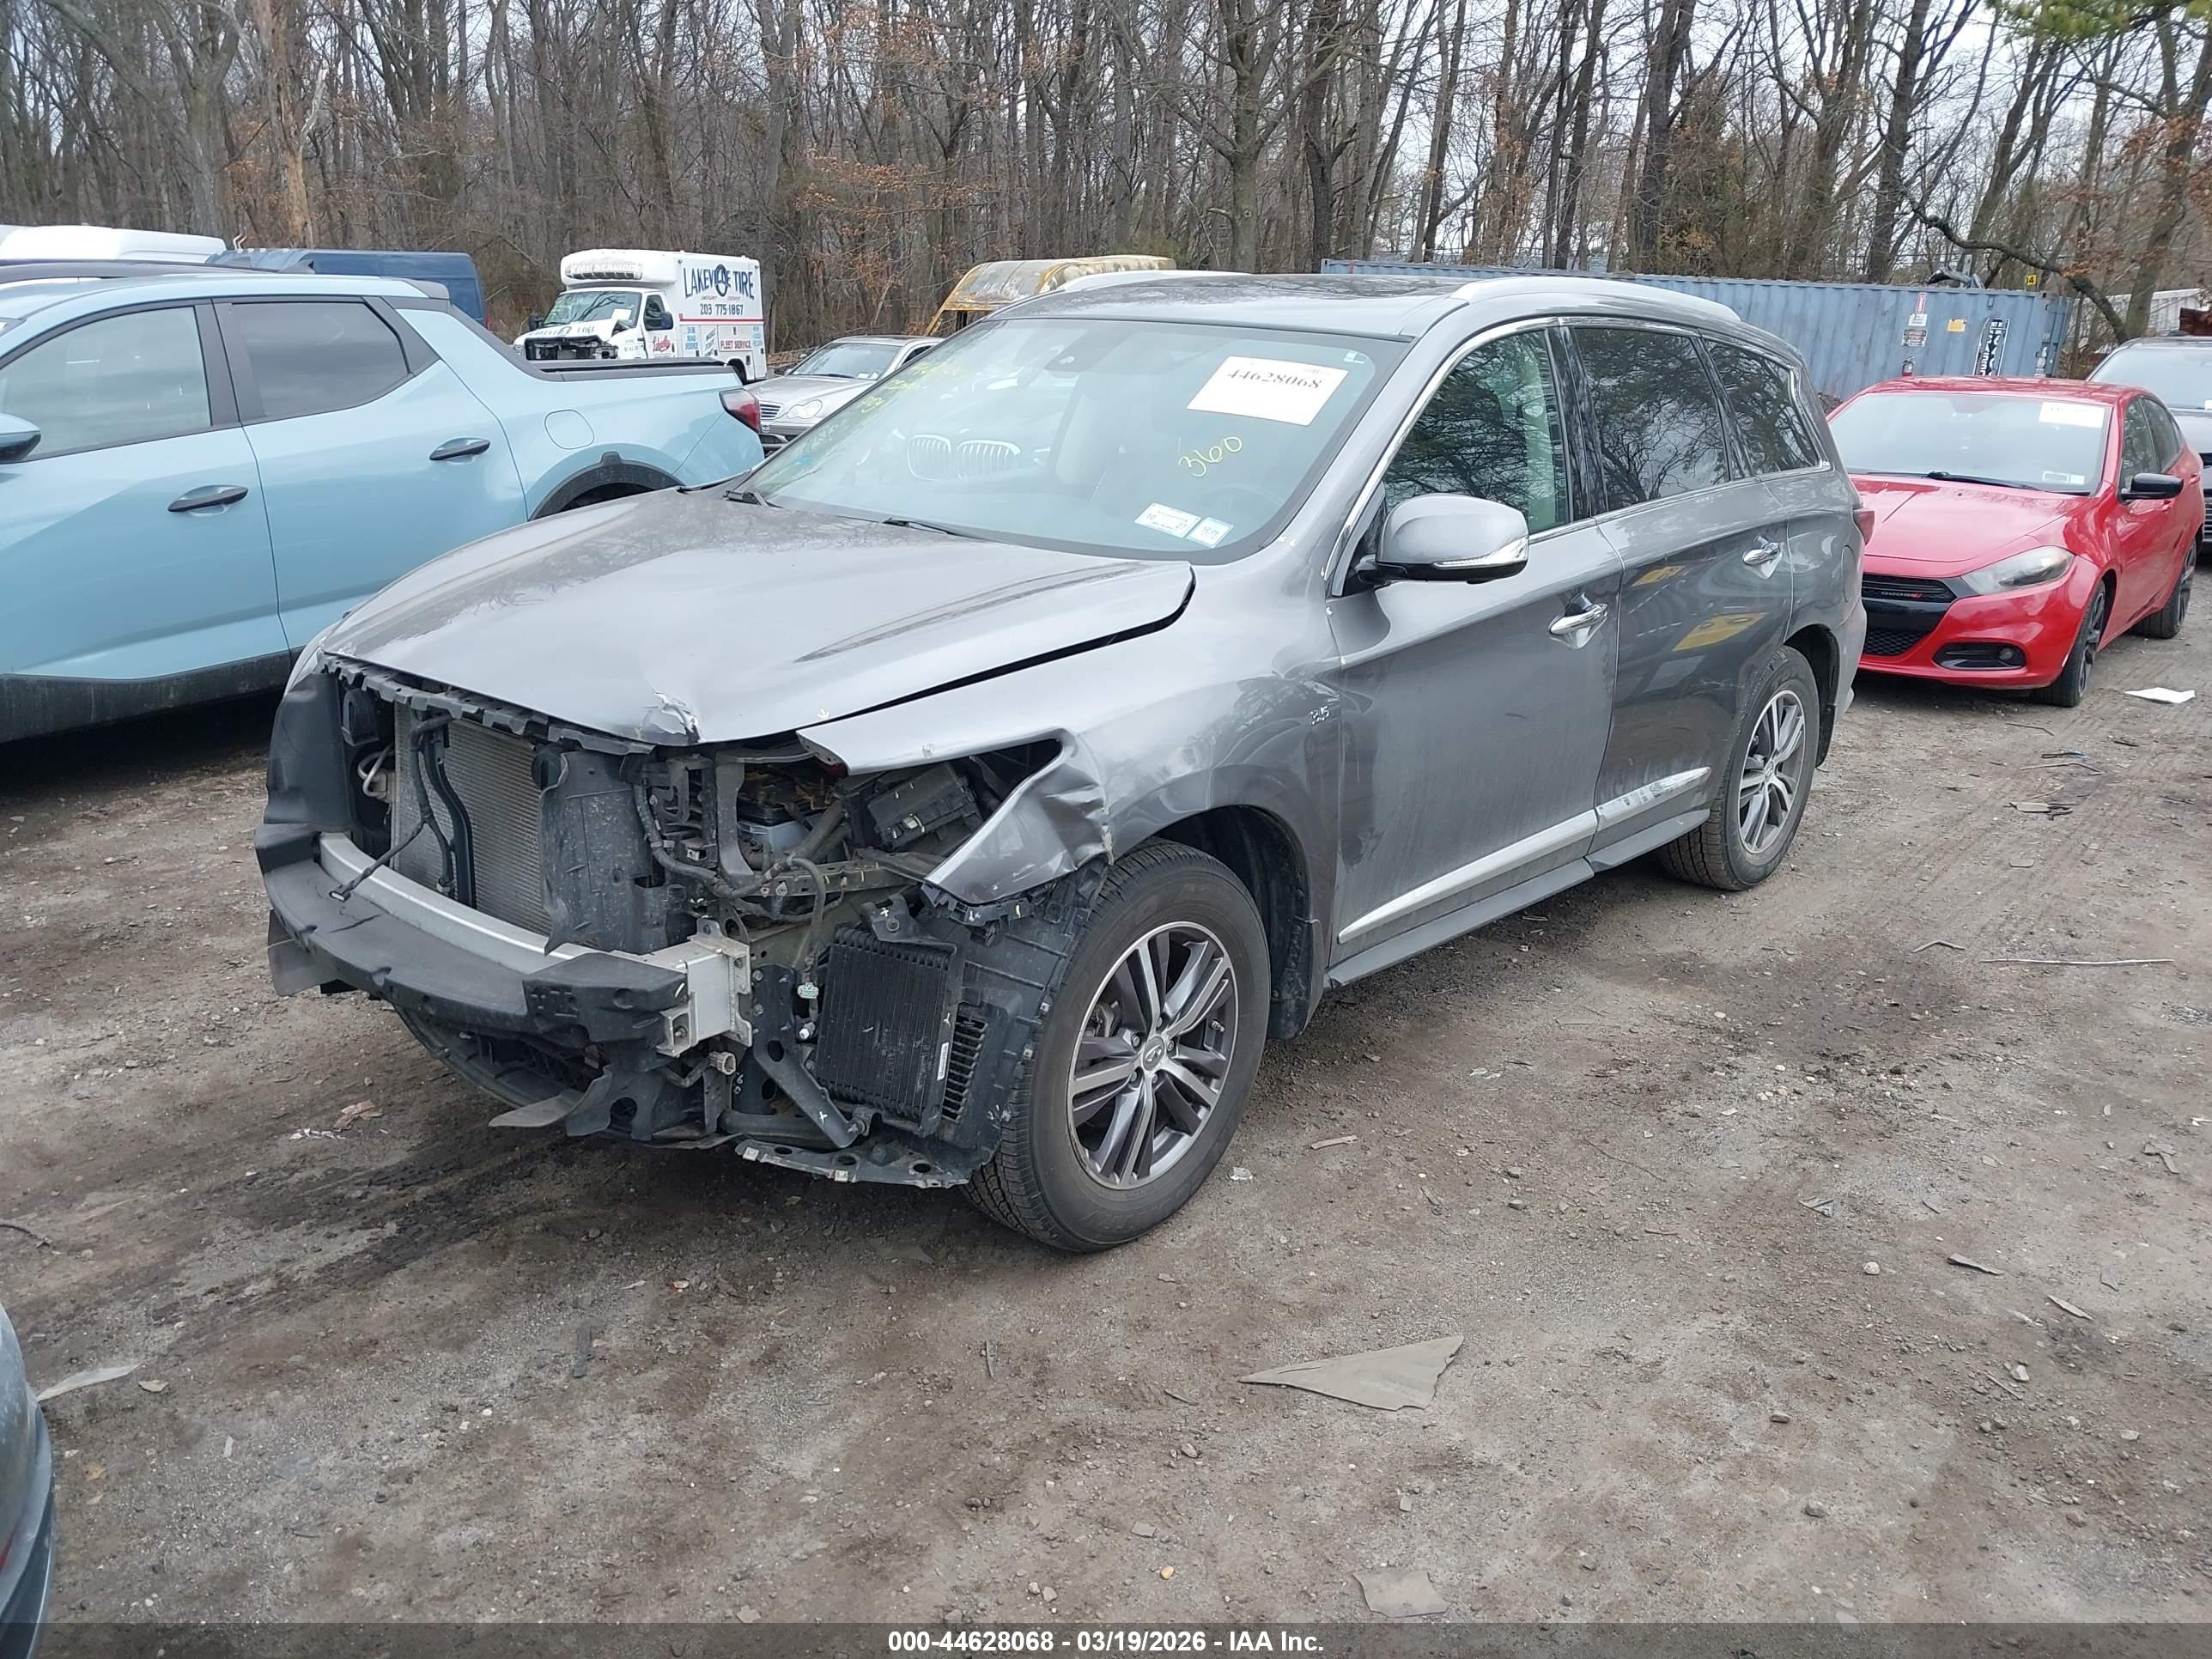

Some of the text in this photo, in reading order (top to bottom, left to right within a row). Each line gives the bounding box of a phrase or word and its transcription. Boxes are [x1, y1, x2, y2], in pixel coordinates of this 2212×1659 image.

[732, 270, 755, 300] TIRE
[700, 303, 712, 316] 203
[720, 340, 733, 349] FLEET
[1226, 368, 1322, 389] 44628068
[1178, 436, 1243, 477] 360
